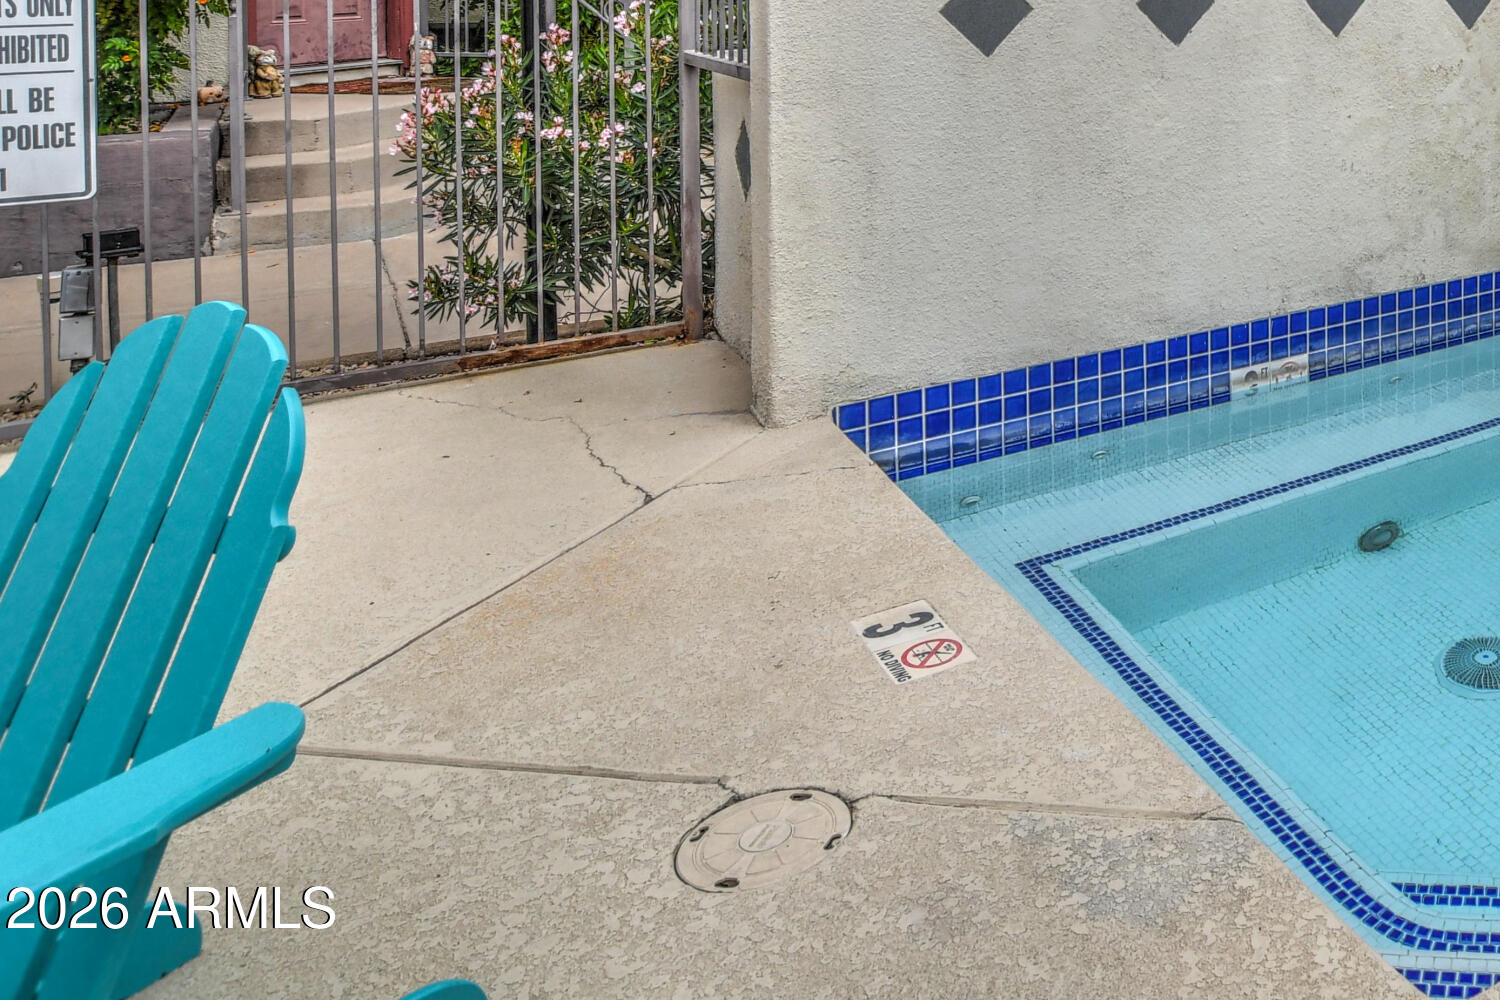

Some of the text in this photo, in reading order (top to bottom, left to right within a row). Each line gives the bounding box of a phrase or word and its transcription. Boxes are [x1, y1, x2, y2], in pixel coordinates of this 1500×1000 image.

[0, 34, 69, 64] HIBITED
[28, 87, 55, 113] BE
[2, 122, 76, 151] POLICE
[1261, 367, 1268, 378] FT
[862, 611, 944, 639] 3 FT
[876, 649, 912, 683] NO DIVING
